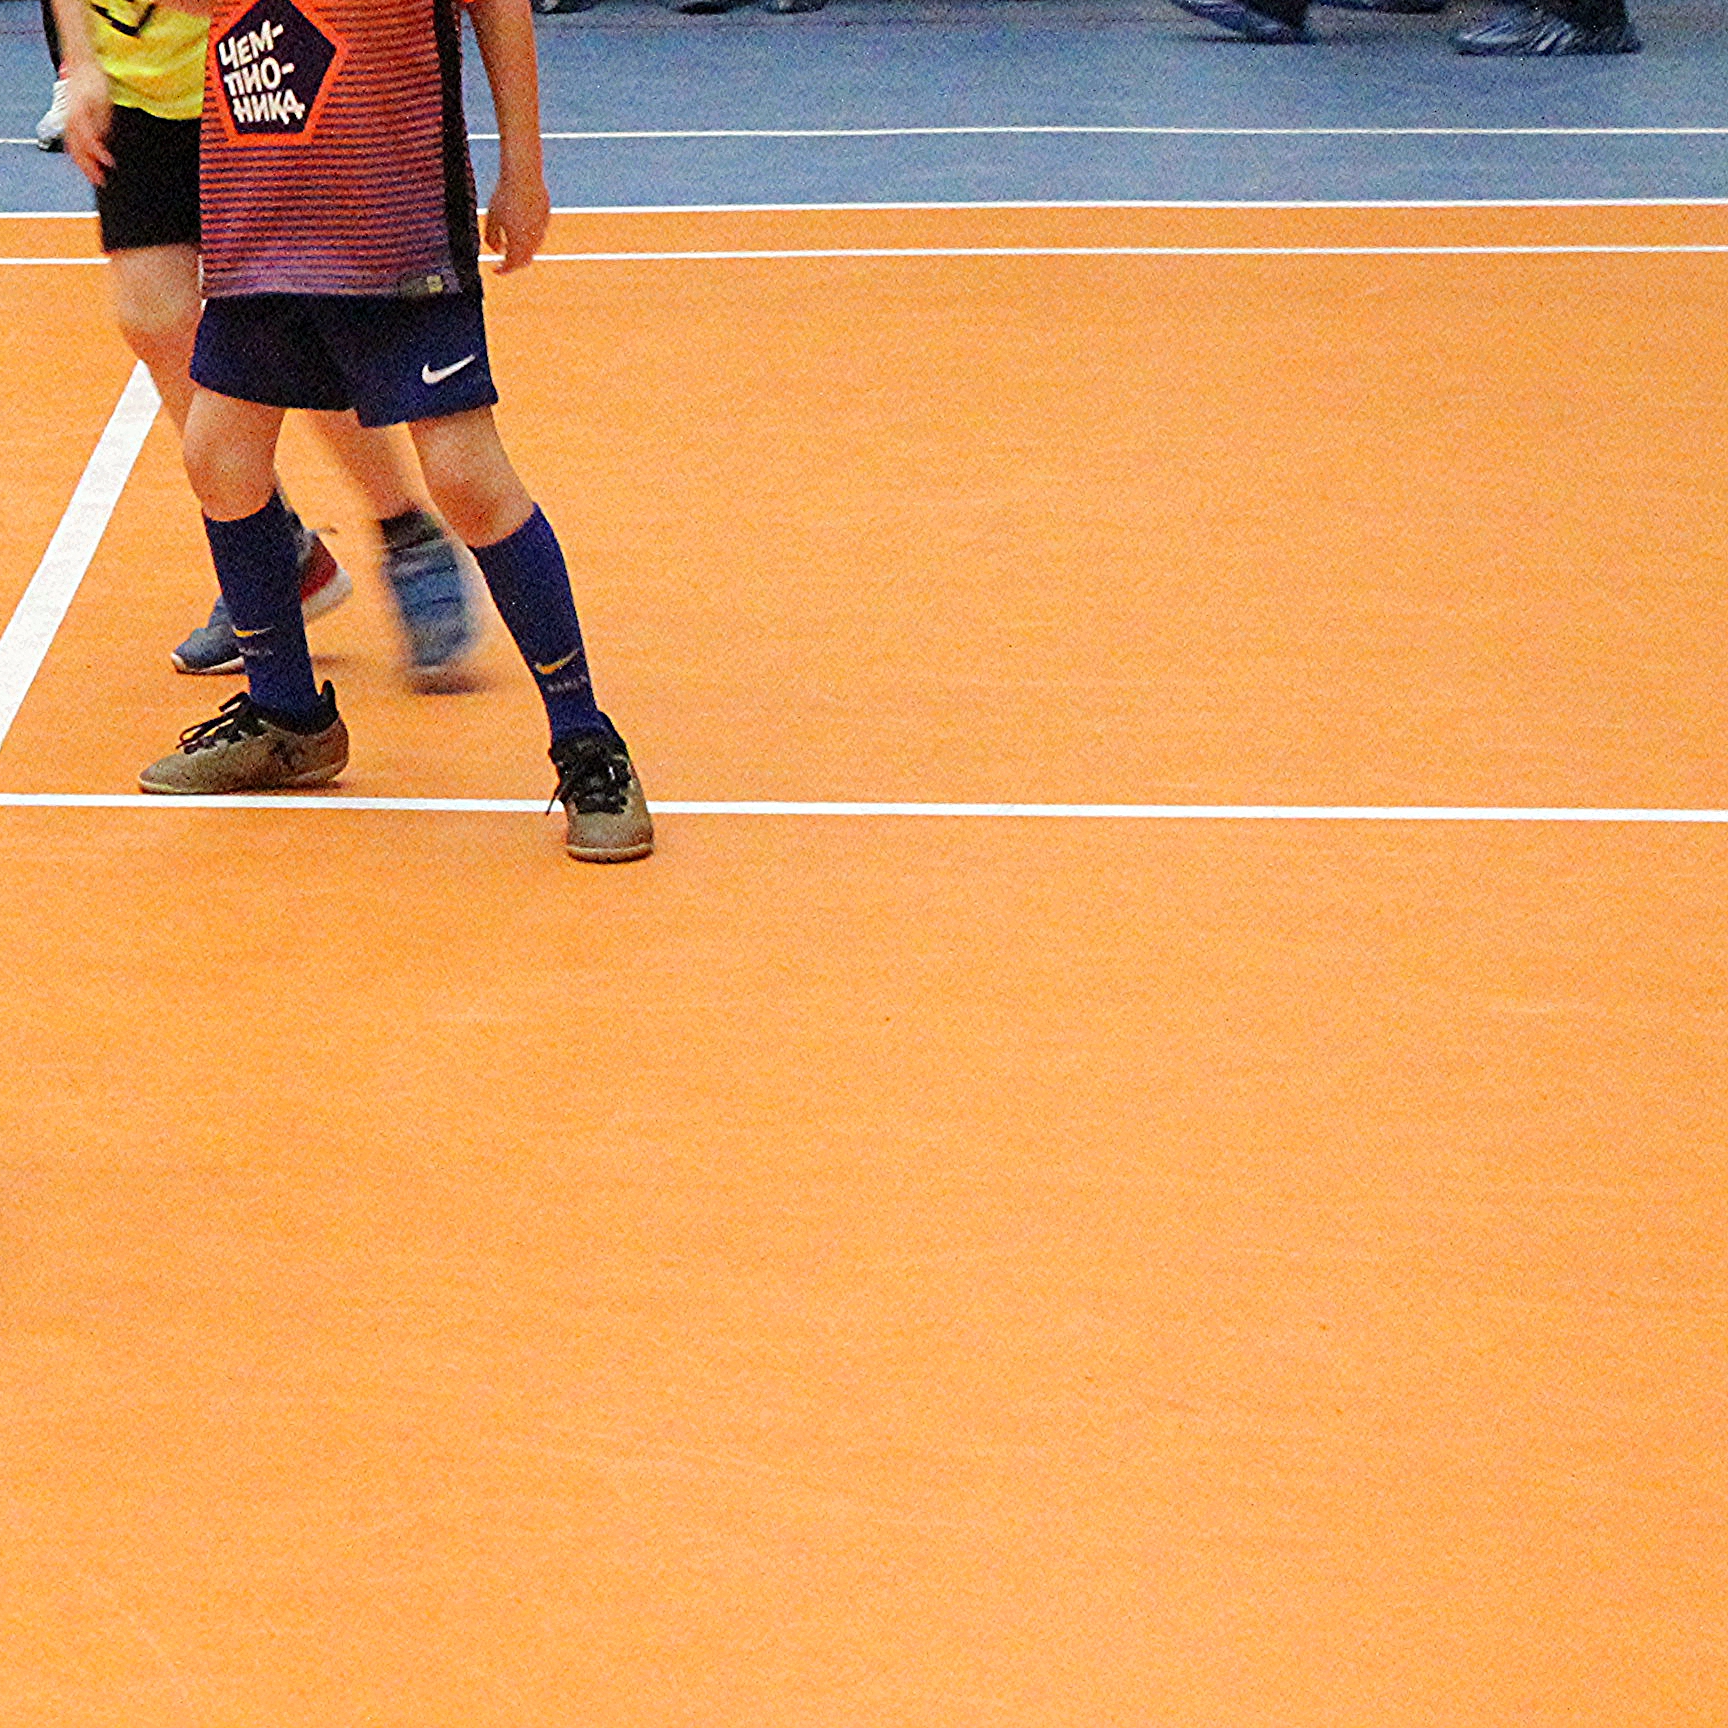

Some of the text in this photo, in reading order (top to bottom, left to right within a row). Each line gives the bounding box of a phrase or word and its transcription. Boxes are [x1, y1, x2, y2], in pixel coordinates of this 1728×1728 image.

[218, 19, 284, 69] ЧЕМ-
[223, 56, 295, 96] ПИО-
[232, 88, 305, 125] НИКА
